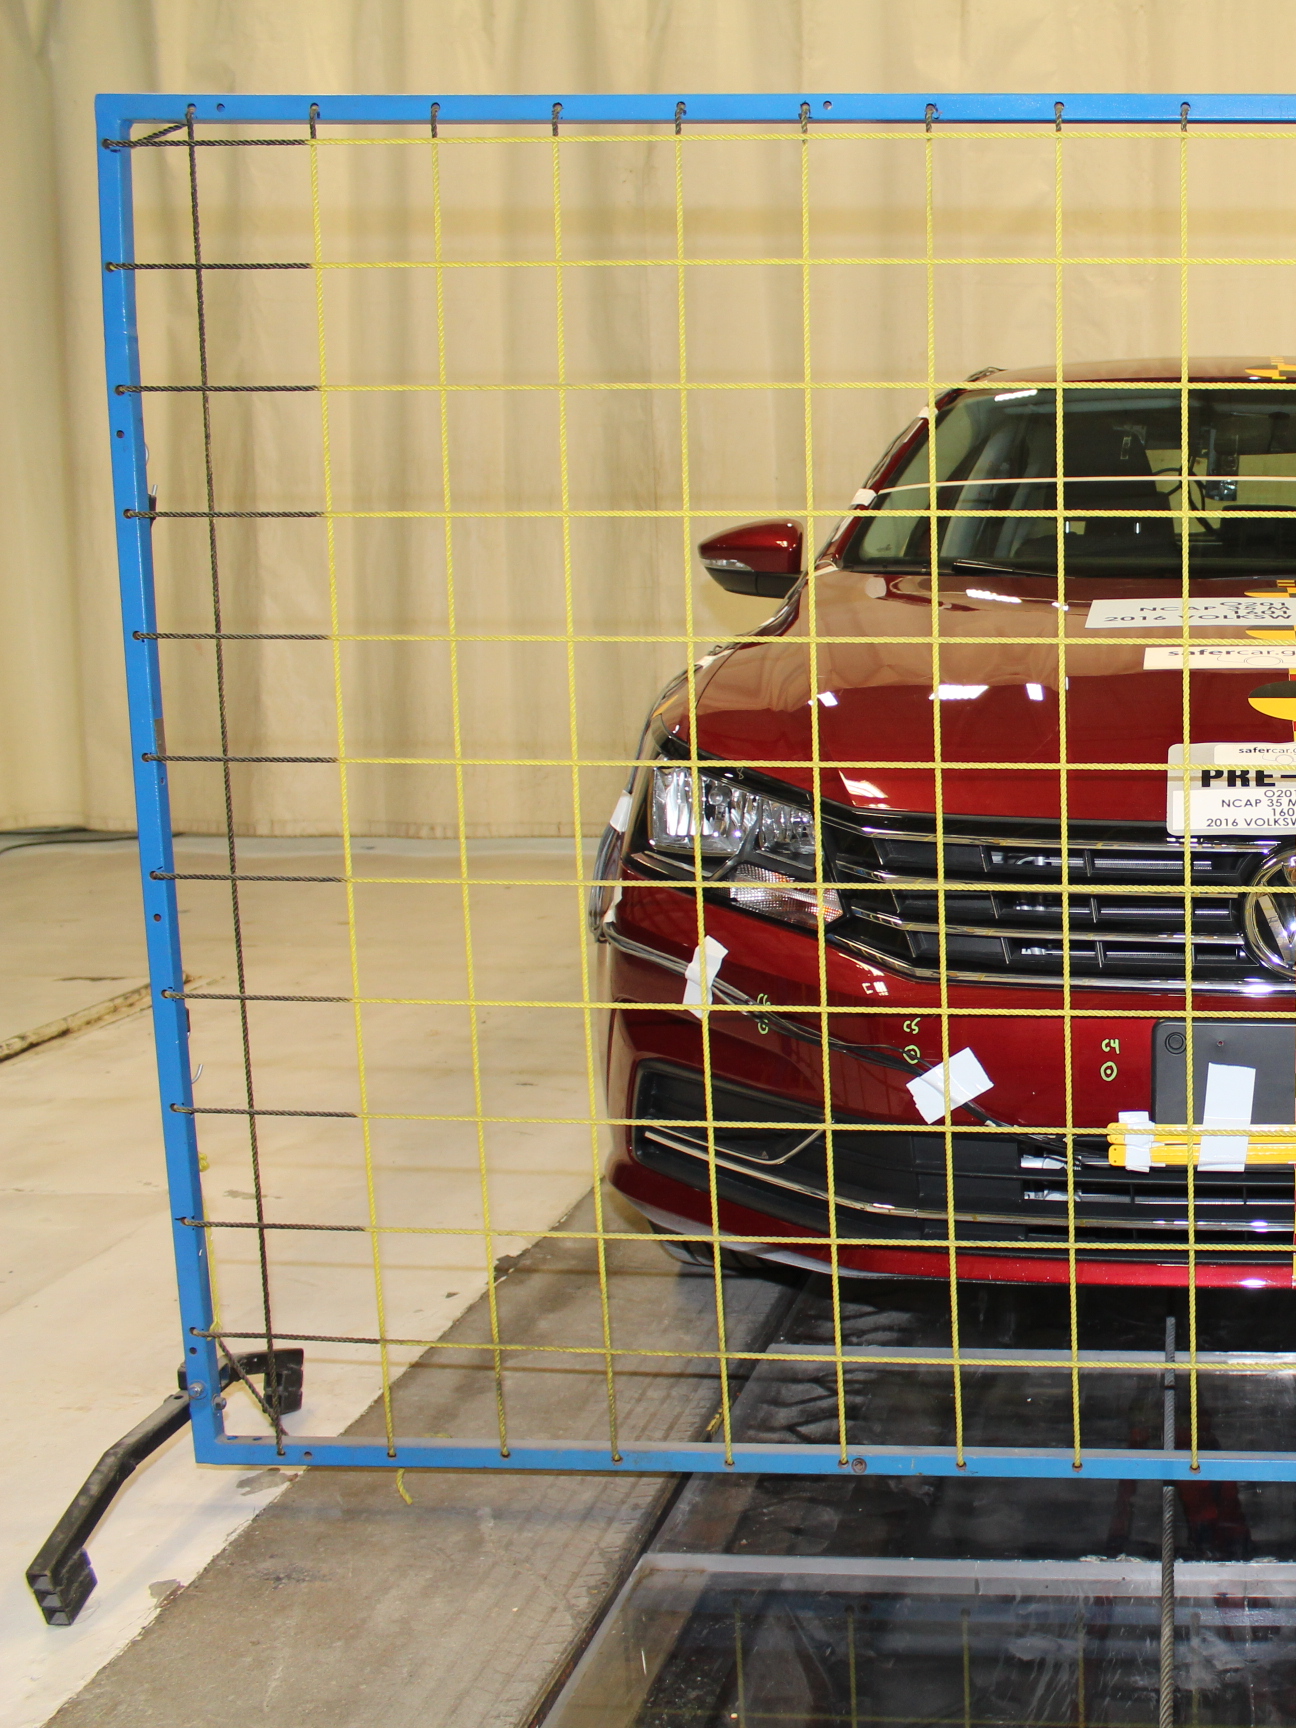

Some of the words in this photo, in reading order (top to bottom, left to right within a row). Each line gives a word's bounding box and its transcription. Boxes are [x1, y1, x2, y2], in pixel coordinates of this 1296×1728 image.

[1221, 798, 1262, 808] NCAP
[1267, 798, 1283, 807] 35
[1206, 818, 1239, 827] 2016
[903, 1017, 921, 1034] C5
[1101, 1038, 1120, 1055] C4
